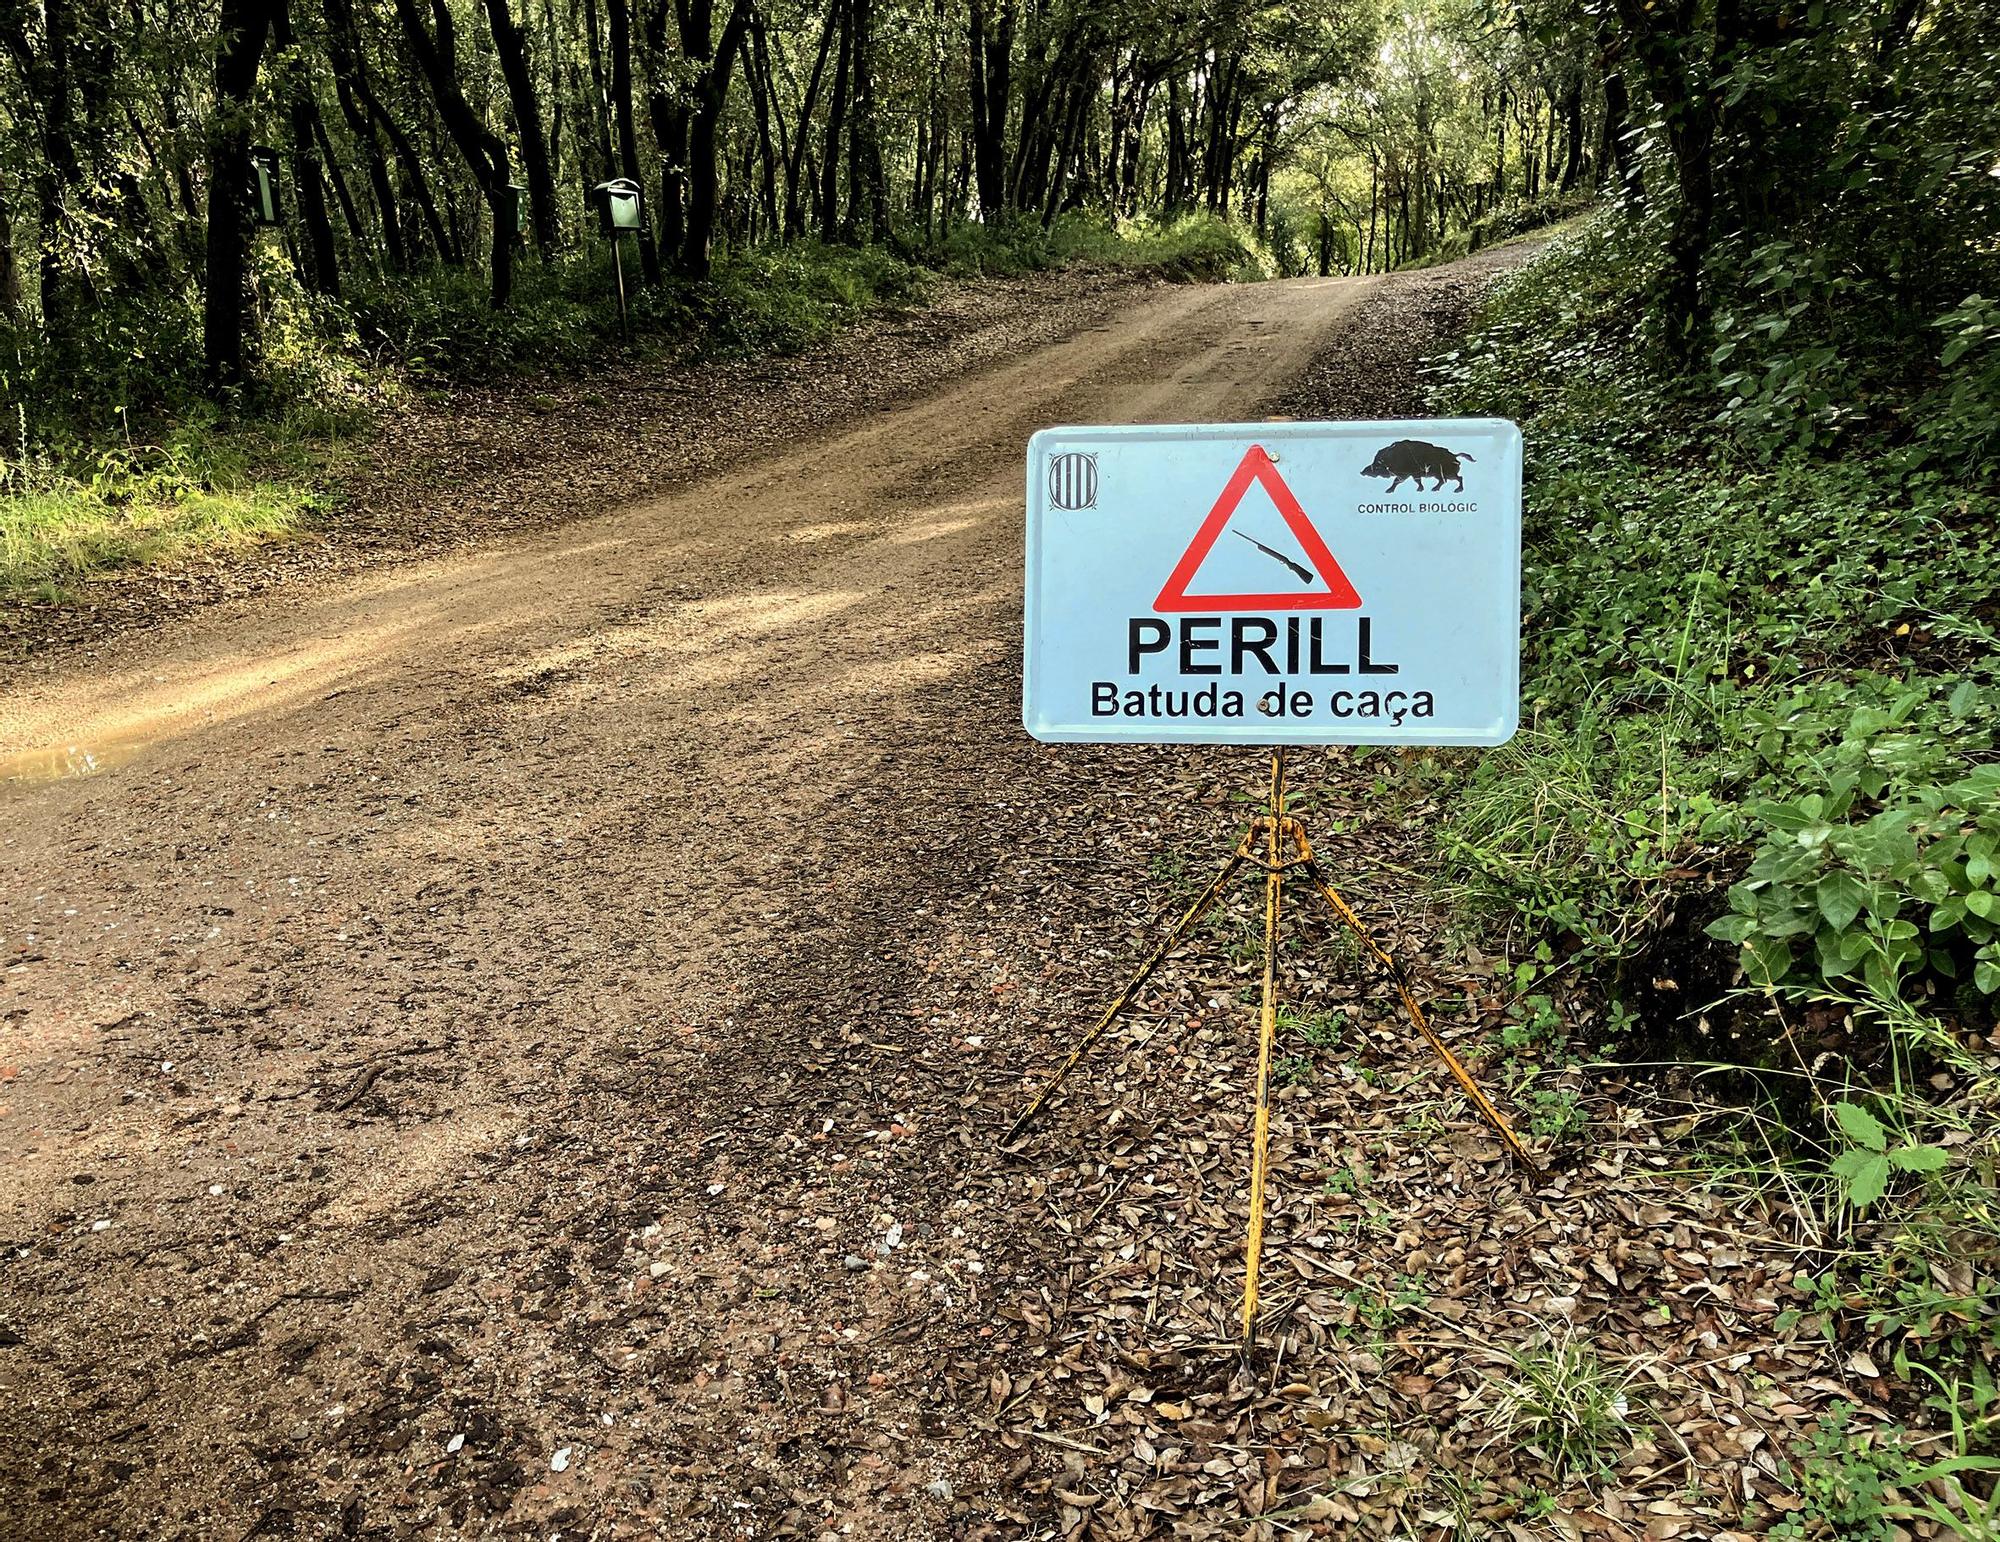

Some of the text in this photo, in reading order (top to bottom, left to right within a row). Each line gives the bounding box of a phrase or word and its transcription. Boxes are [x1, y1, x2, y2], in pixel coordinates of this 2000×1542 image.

[1357, 503, 1416, 514] CONTROL
[1128, 616, 1399, 675] PERILL
[1091, 681, 1434, 727] Batuda de caça
